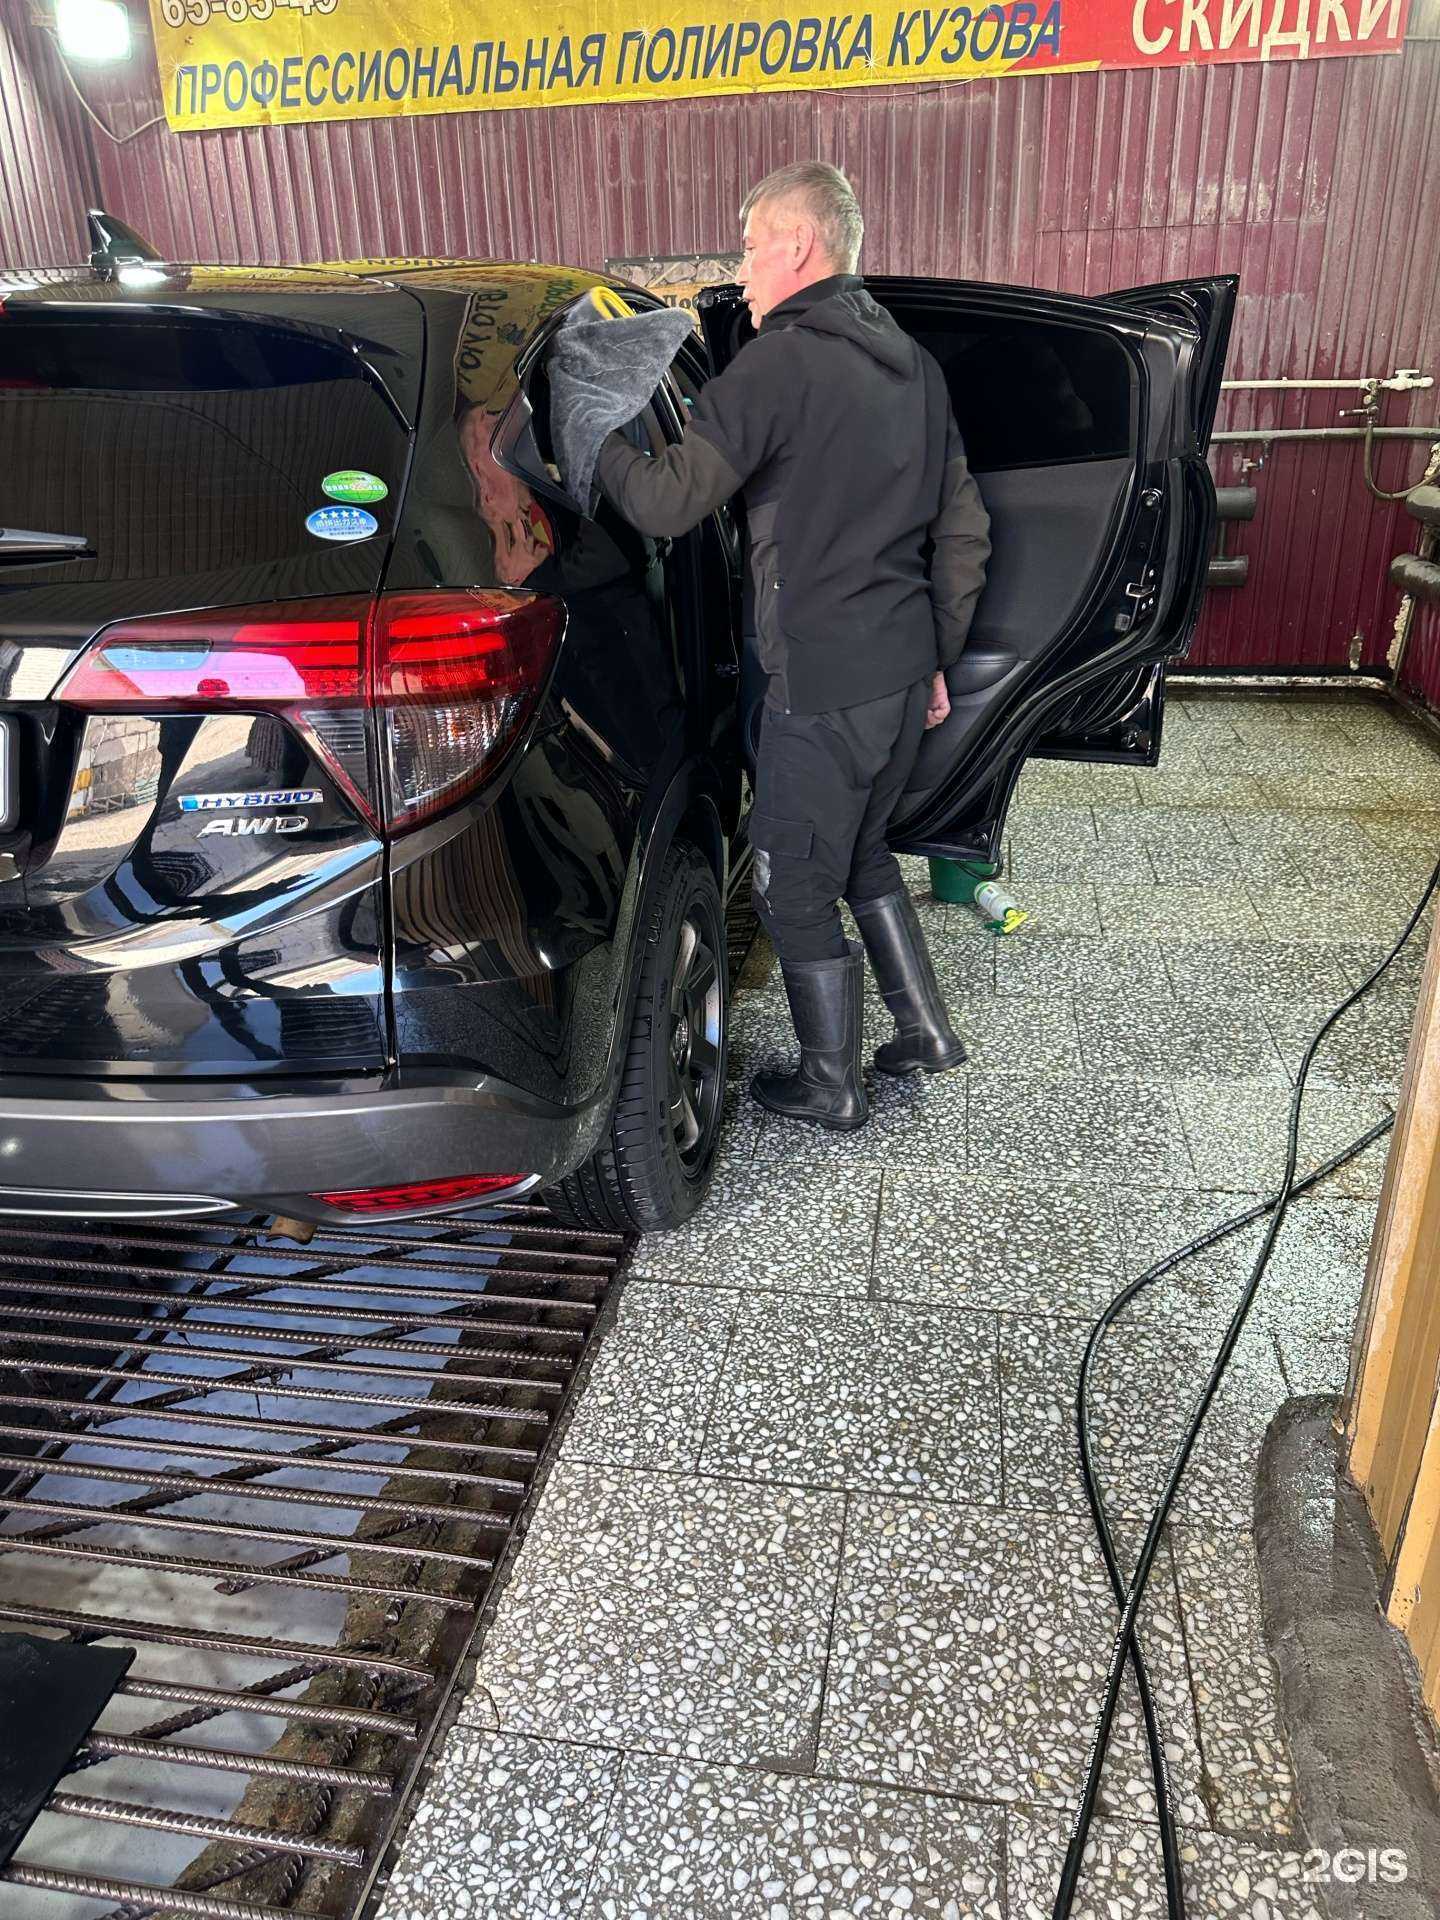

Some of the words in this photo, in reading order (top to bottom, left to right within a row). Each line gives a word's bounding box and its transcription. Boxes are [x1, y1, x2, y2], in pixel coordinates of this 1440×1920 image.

[1132, 0, 1402, 61] СКИДКИ
[175, 33, 607, 116] ПРОФЕССИОНАЛЬНАЯ
[615, 13, 872, 84] ПОЛИРОВКА
[887, 0, 1061, 67] КУЗОВА
[202, 791, 313, 807] HYBRID
[196, 815, 309, 838] AWD
